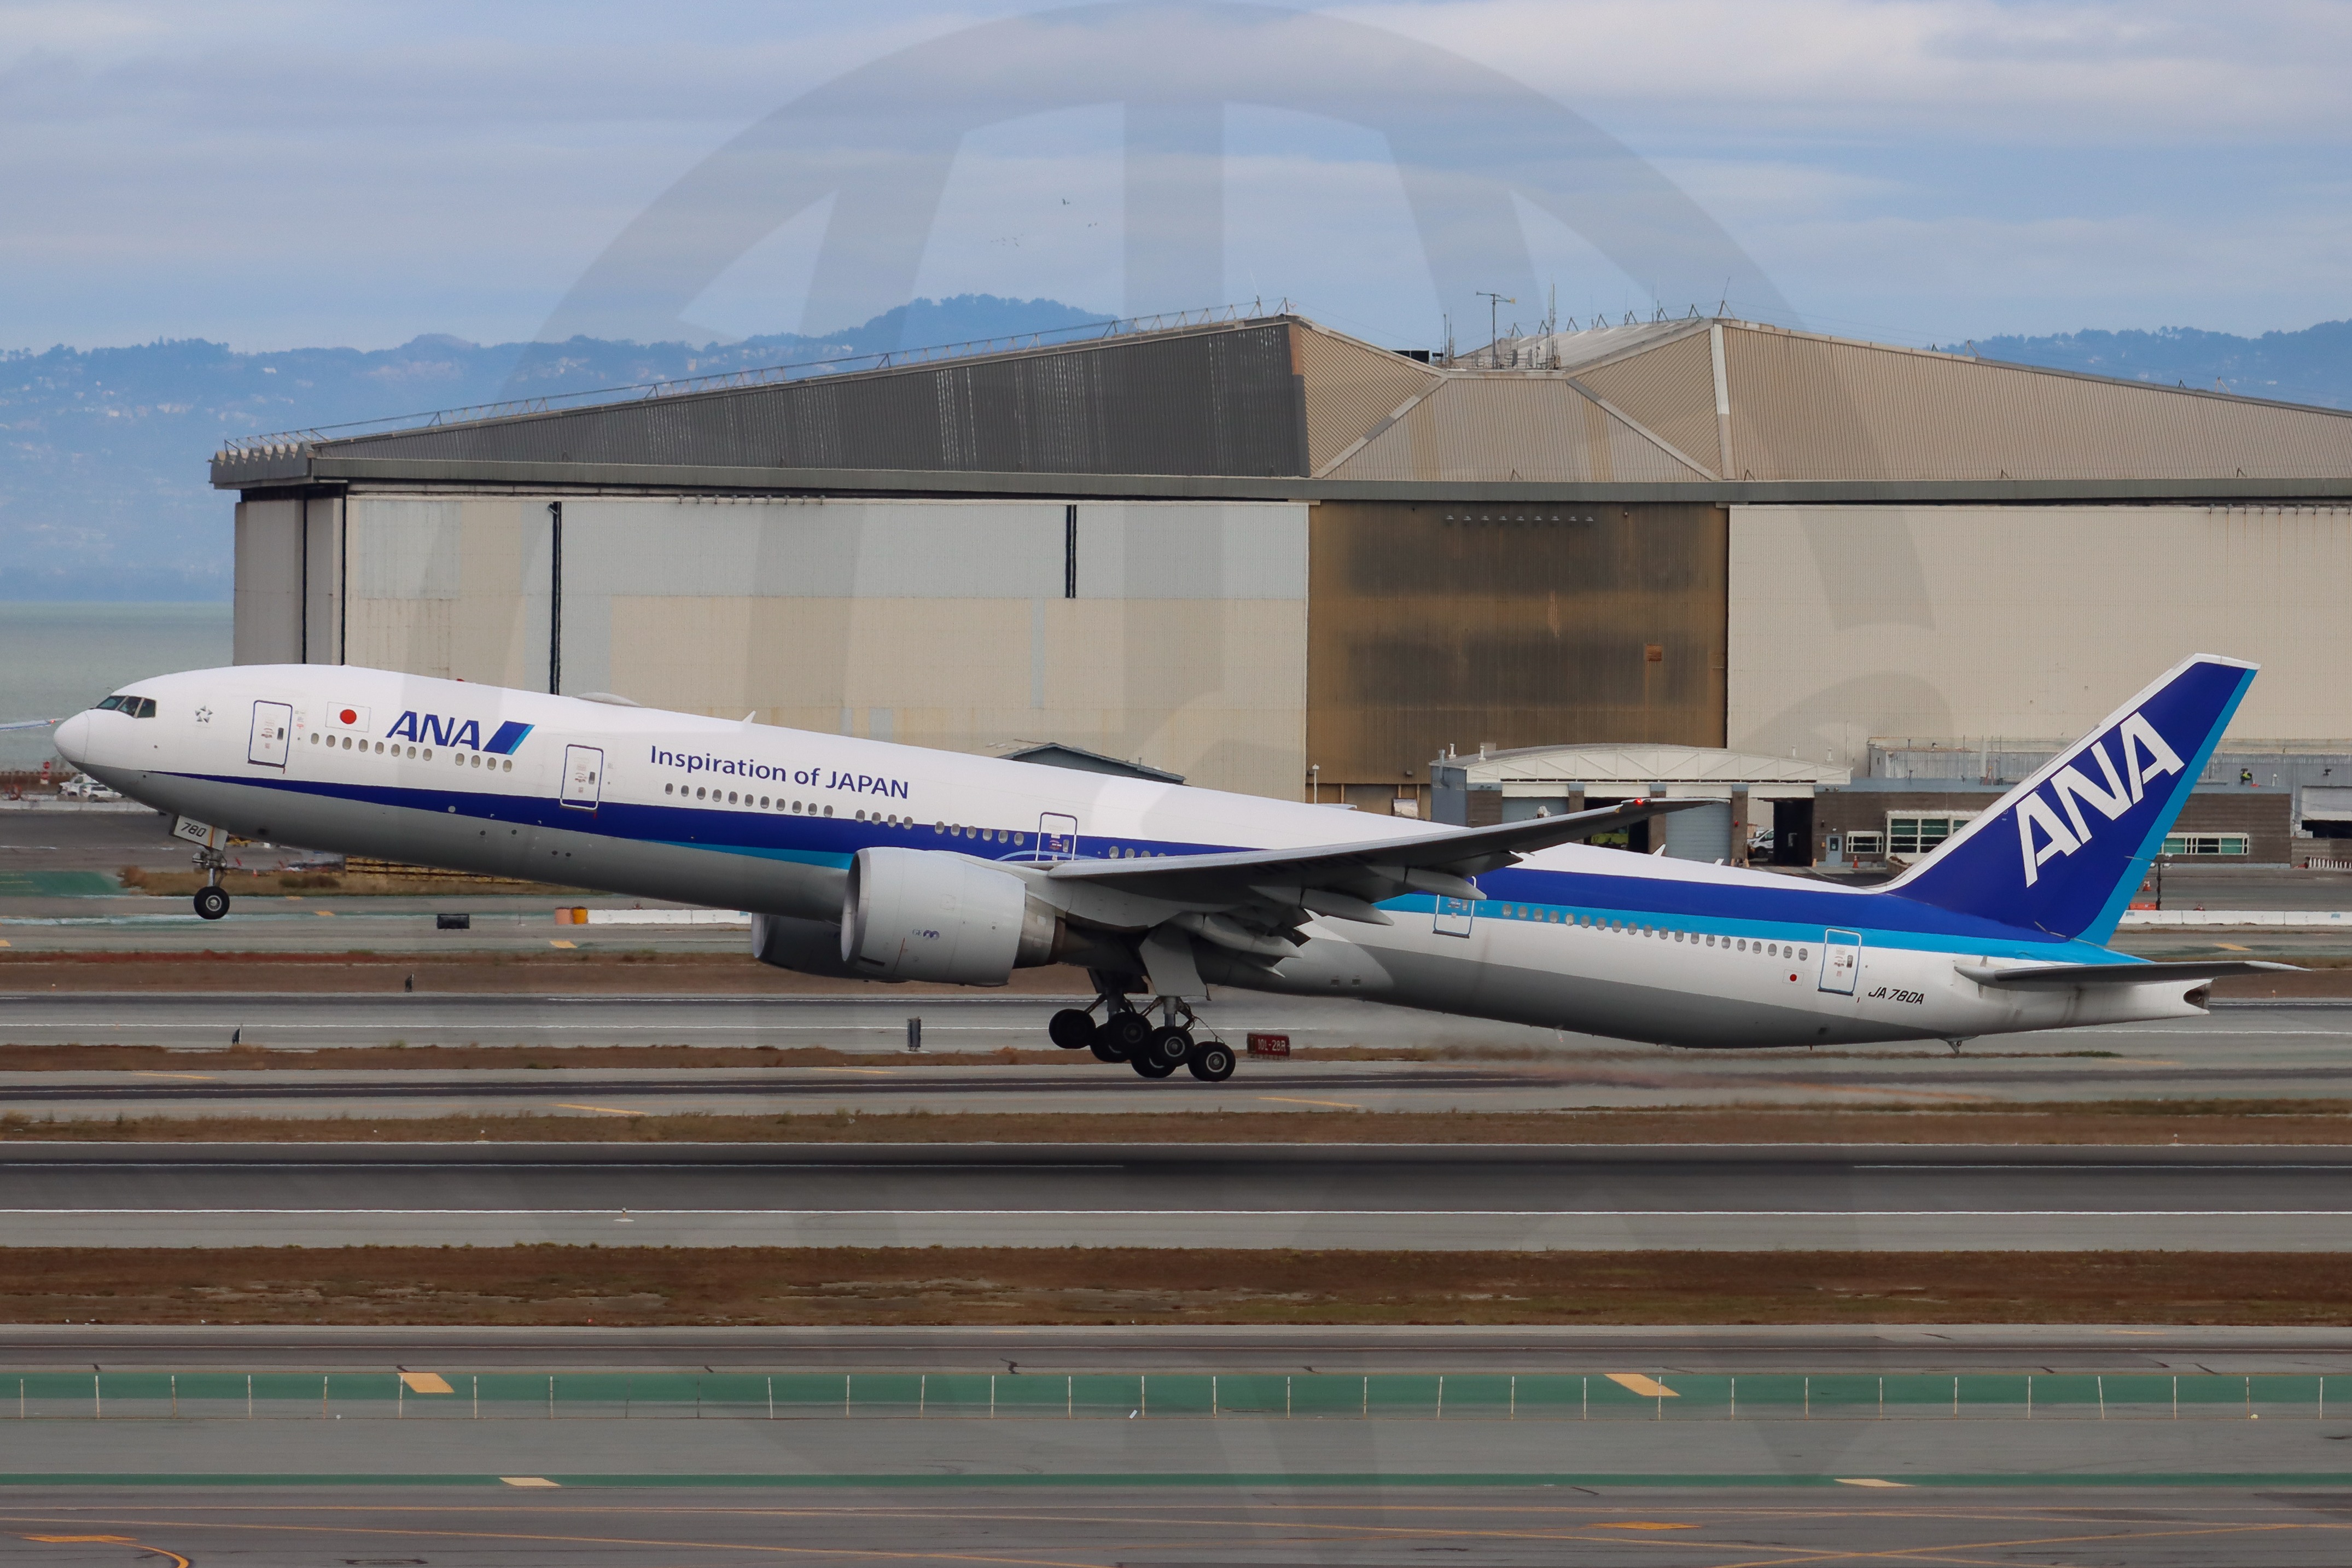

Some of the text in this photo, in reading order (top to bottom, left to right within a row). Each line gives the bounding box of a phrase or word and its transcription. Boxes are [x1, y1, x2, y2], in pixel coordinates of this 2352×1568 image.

[386, 710, 480, 751] ANA
[651, 745, 909, 799] Inspiration of JAPAN
[2016, 711, 2185, 888] ANA
[181, 822, 207, 837] 780
[1867, 986, 1925, 1005] JA780A
